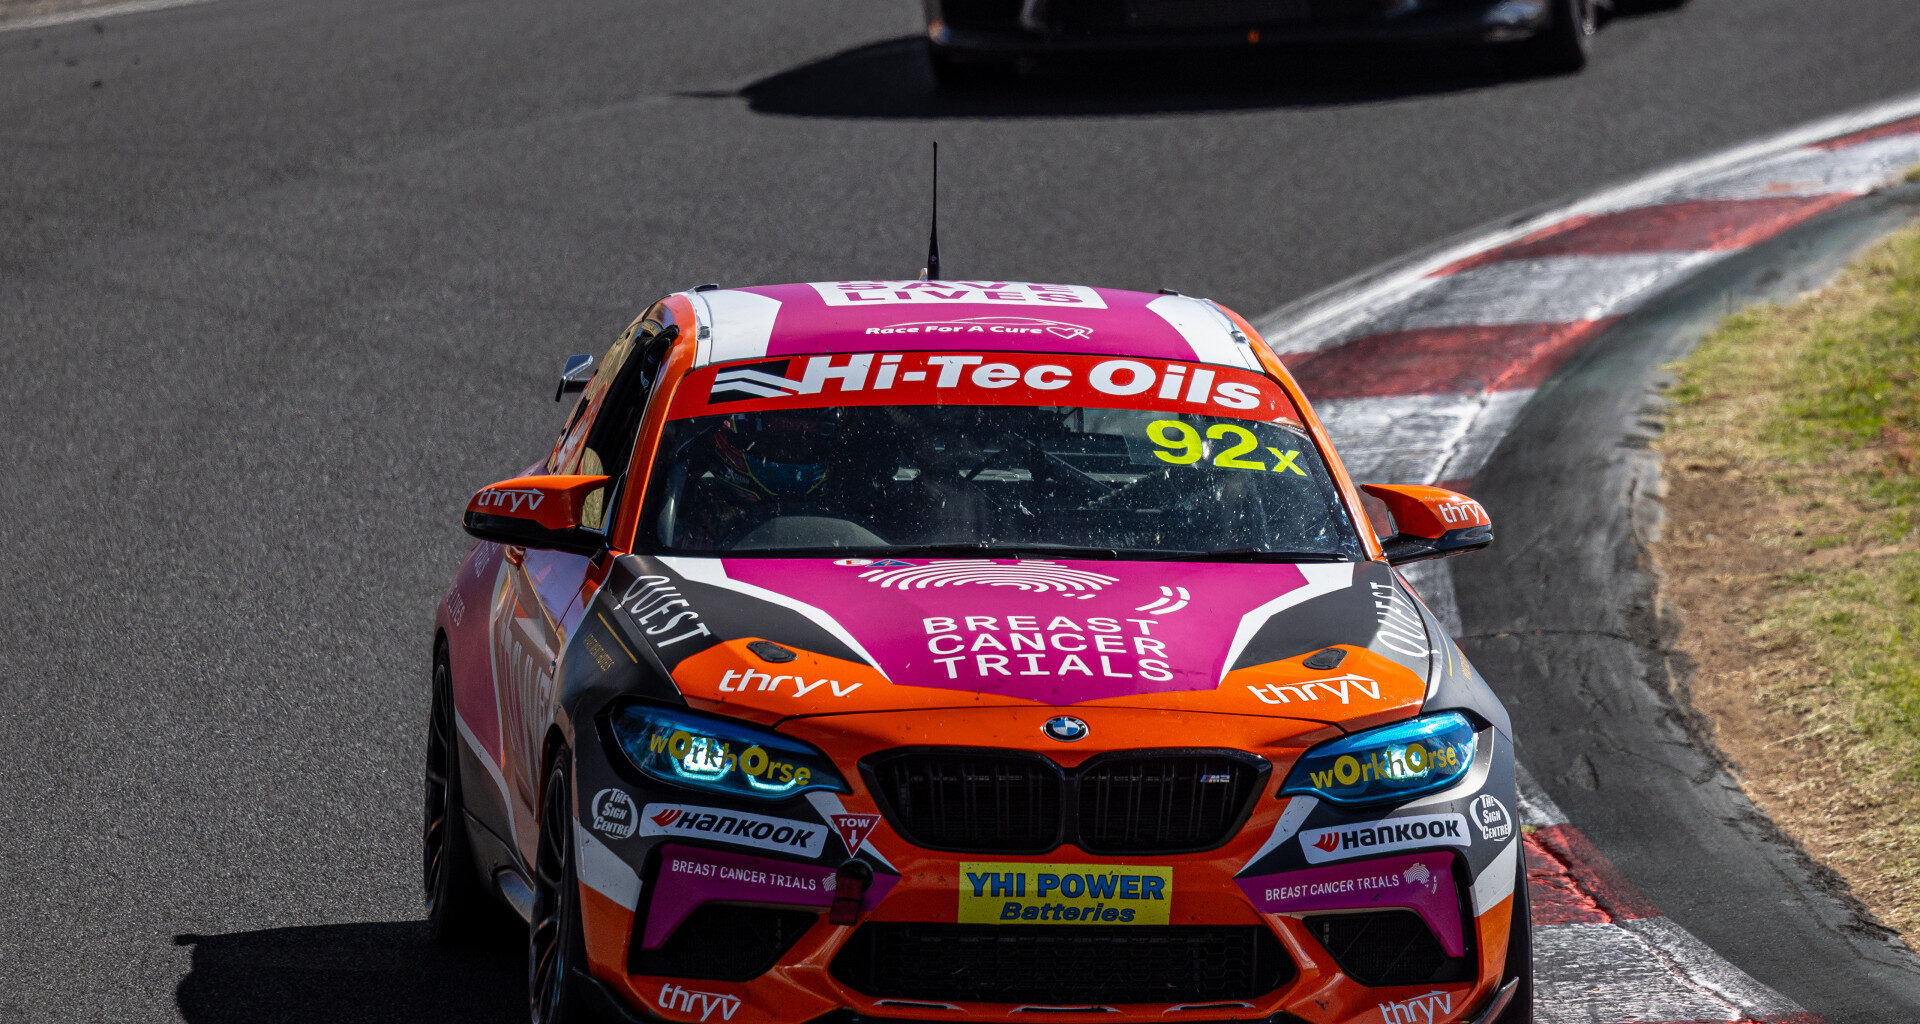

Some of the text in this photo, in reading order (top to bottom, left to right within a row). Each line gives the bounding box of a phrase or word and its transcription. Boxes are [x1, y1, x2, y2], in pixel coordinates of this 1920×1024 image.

[837, 283, 1074, 293] SAVE
[845, 290, 1084, 304] LIVES
[865, 325, 1043, 335] Race For A Cure
[797, 354, 1261, 410] Hi-Tec Oils
[477, 488, 545, 512] thryv
[613, 575, 711, 649] QUEST
[1369, 581, 1441, 658] QUEST
[922, 616, 1158, 635] BREAST
[928, 633, 1168, 659] CANCER
[933, 654, 1174, 681] TRIALS
[718, 668, 863, 699] thryv
[1246, 673, 1381, 705] thryv
[609, 788, 629, 803] THE
[602, 803, 628, 820] SIGN
[839, 818, 870, 828] TOW
[1483, 809, 1502, 822] SIGN
[593, 815, 630, 836] CENTRE
[1482, 825, 1510, 841] CENTRE
[672, 860, 816, 891] BREAST CANCER TRIALS
[966, 872, 1165, 900] YHI POWER
[1265, 874, 1400, 901] BREAST CANCER TRIALS
[1000, 902, 1136, 922] Batteries
[658, 983, 741, 1022] thryv
[1378, 993, 1451, 1024] thryv
